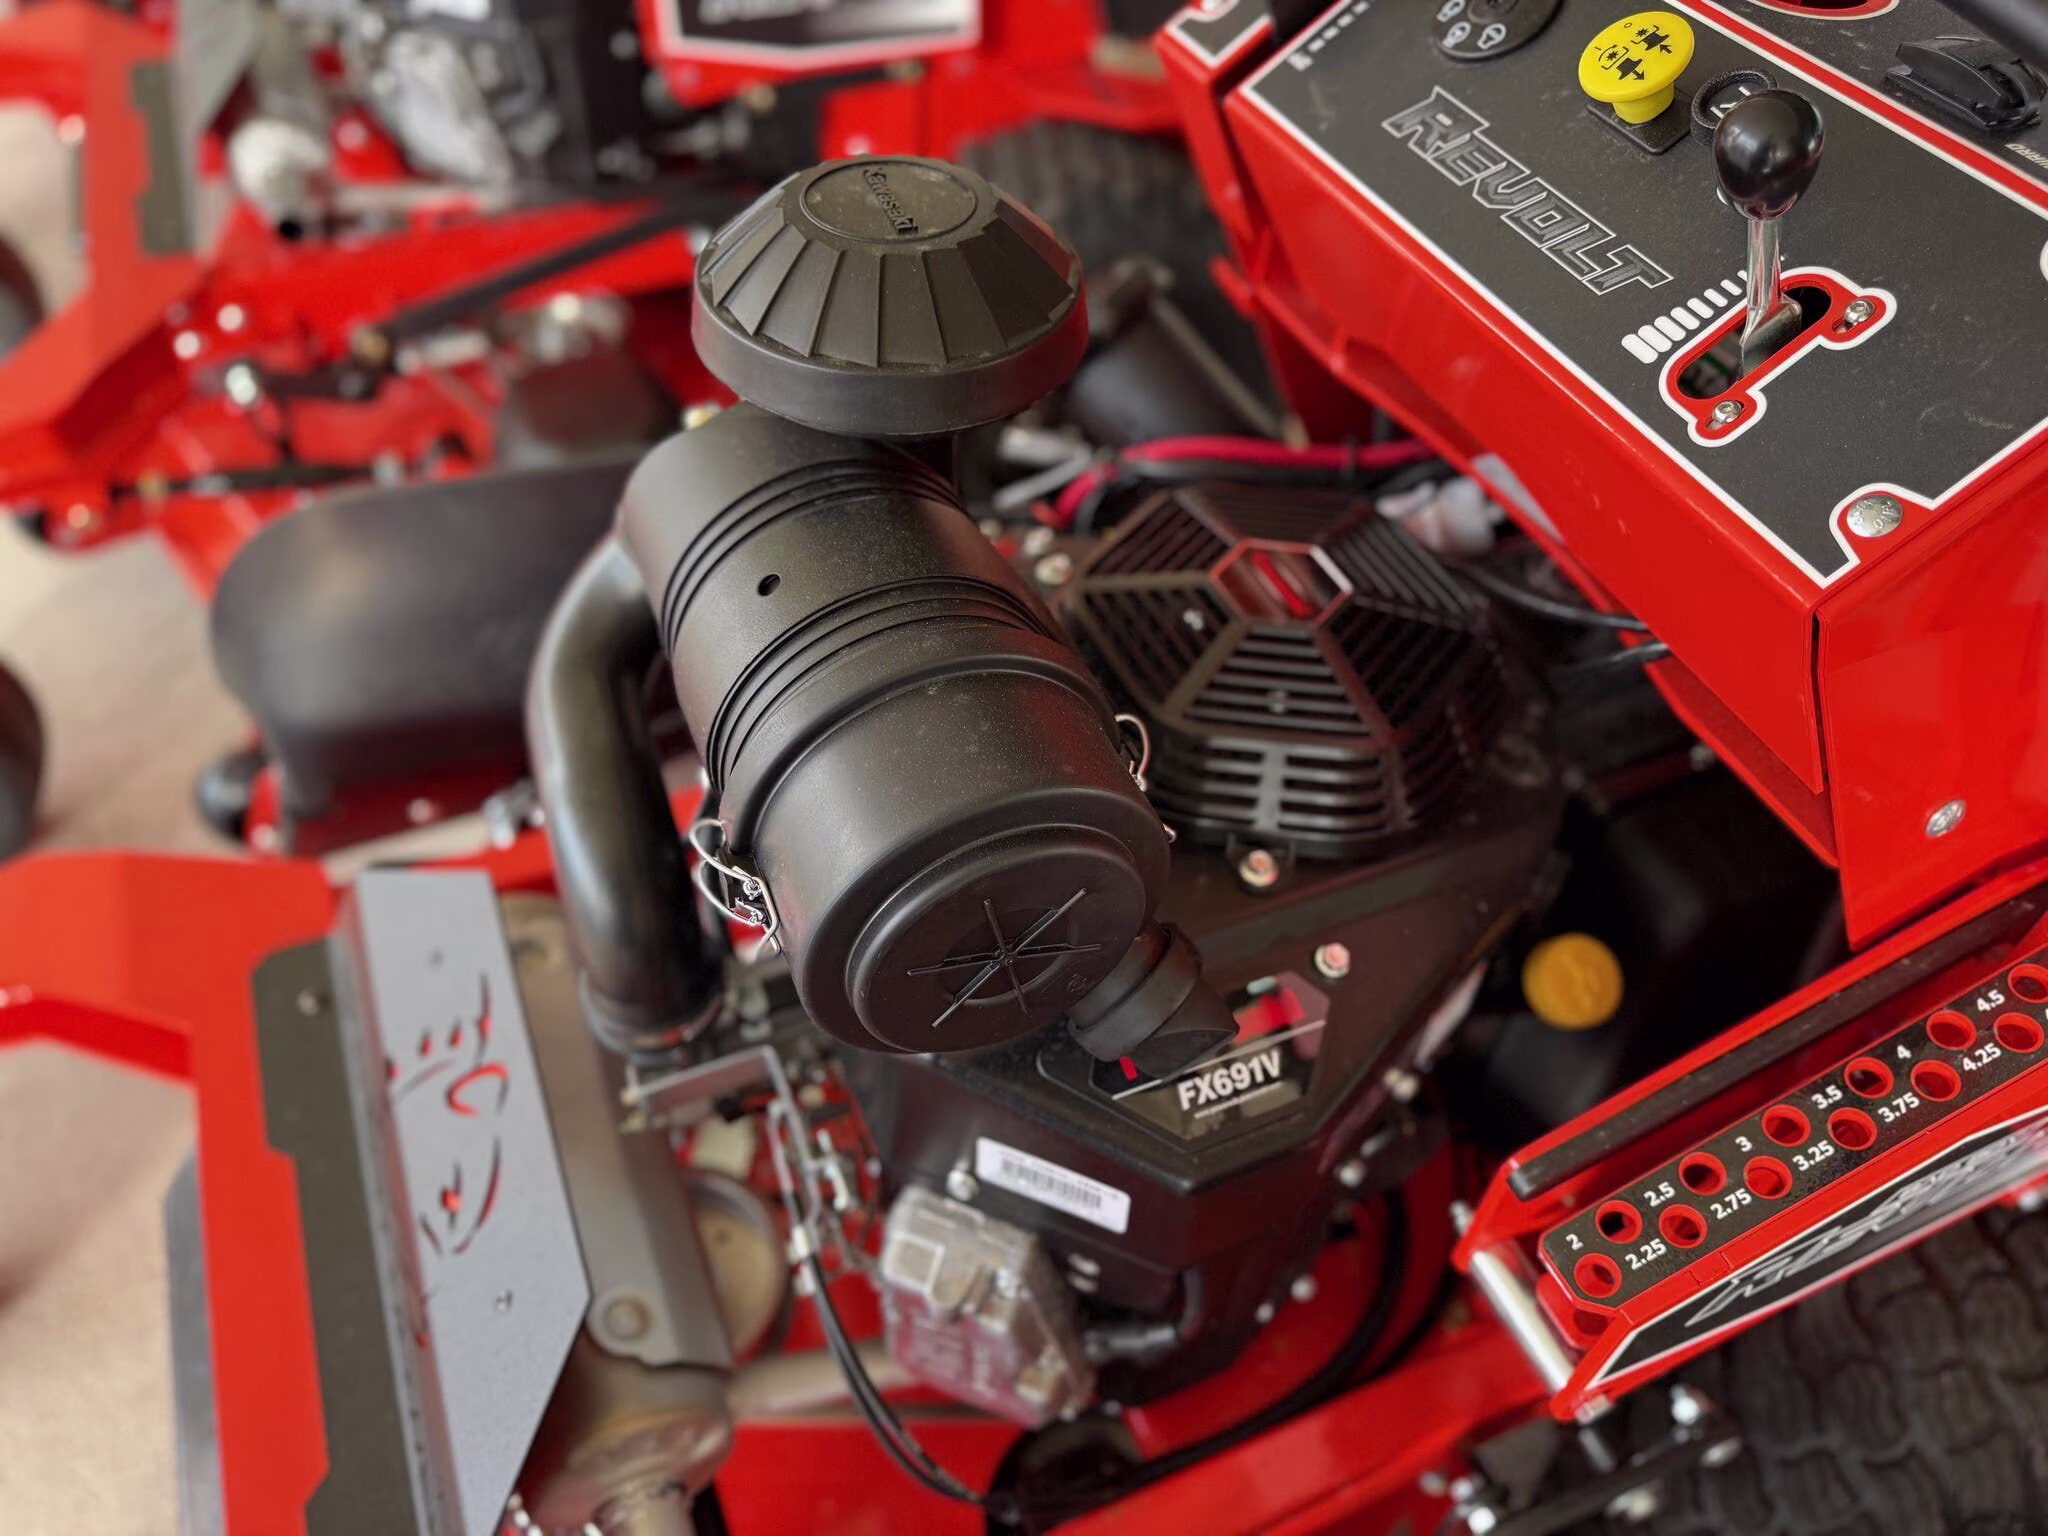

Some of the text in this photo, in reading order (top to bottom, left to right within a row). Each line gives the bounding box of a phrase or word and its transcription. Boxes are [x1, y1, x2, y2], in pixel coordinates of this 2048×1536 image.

[864, 167, 918, 234] Kawasaki
[1381, 86, 1674, 296] REVOLT
[1177, 1048, 1281, 1112] FX691V
[1565, 988, 2006, 1251] 2 2.5 3 3.5 4 4.5
[1624, 1042, 2002, 1271] 2.25 2.75 3.25 3.75 4.25
